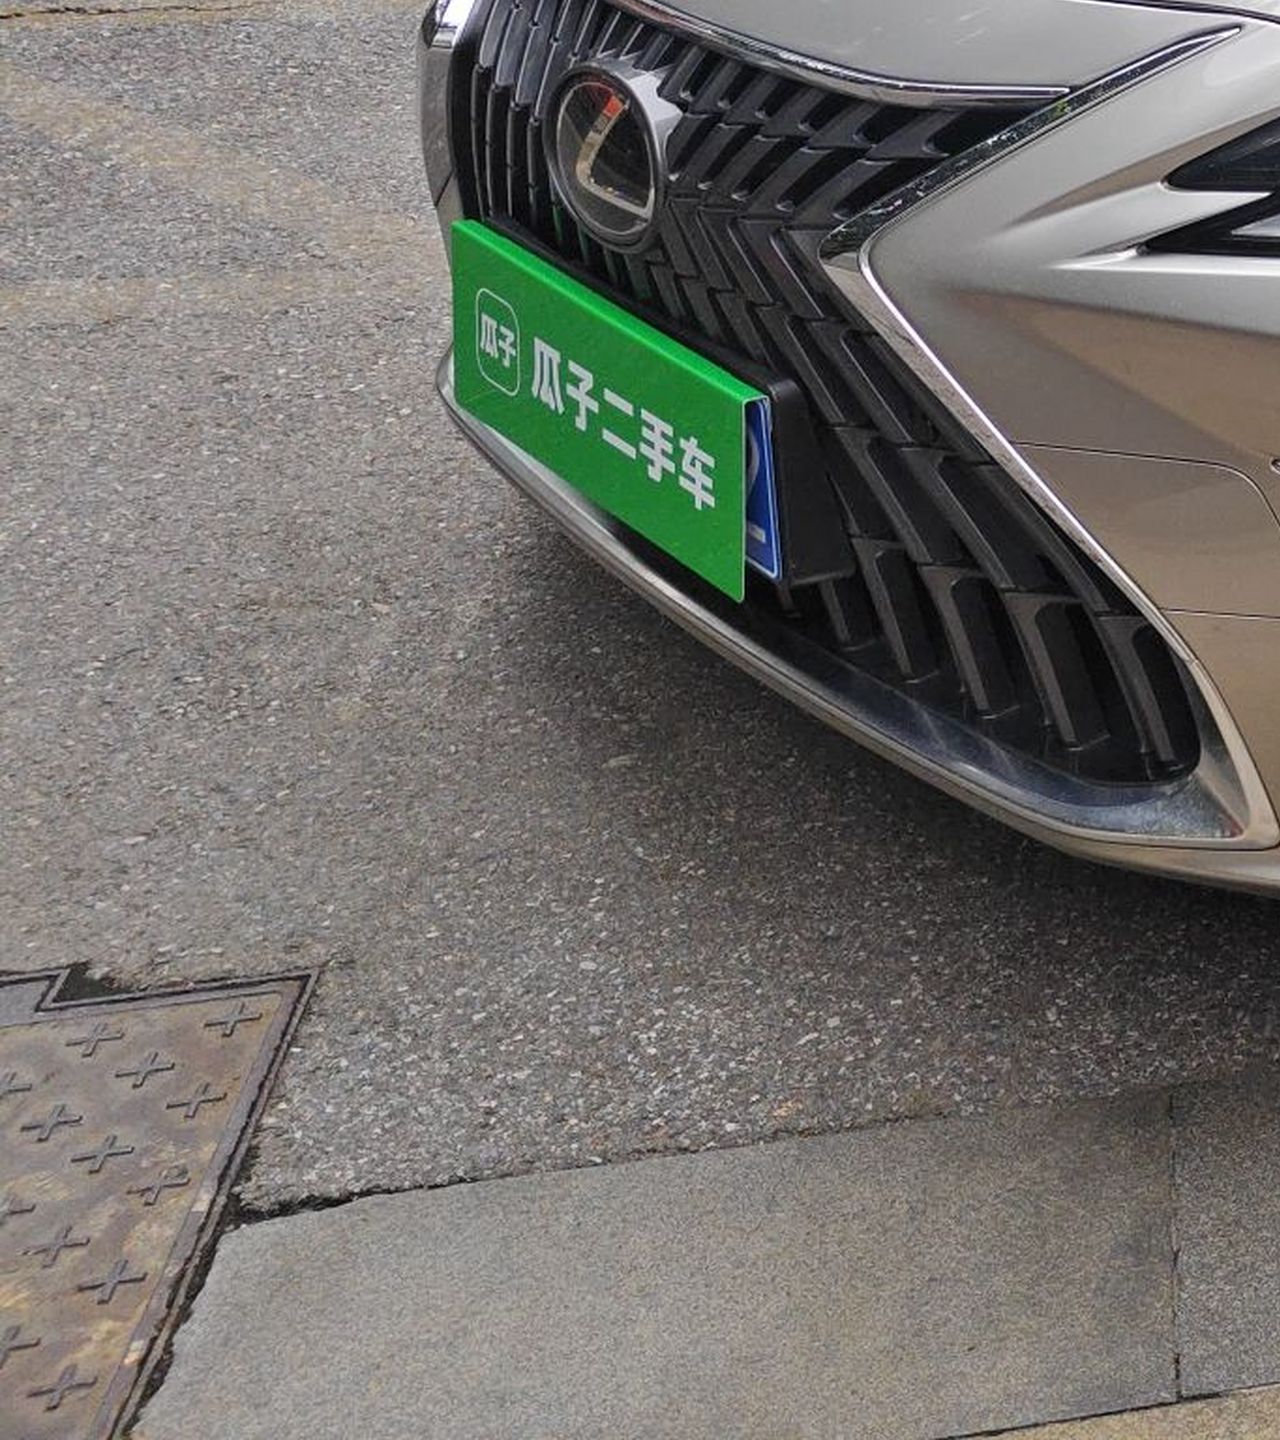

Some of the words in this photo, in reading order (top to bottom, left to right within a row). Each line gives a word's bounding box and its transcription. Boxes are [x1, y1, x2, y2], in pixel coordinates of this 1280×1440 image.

[480, 312, 517, 368] 瓜子
[531, 336, 716, 511] 瓜子二手车
